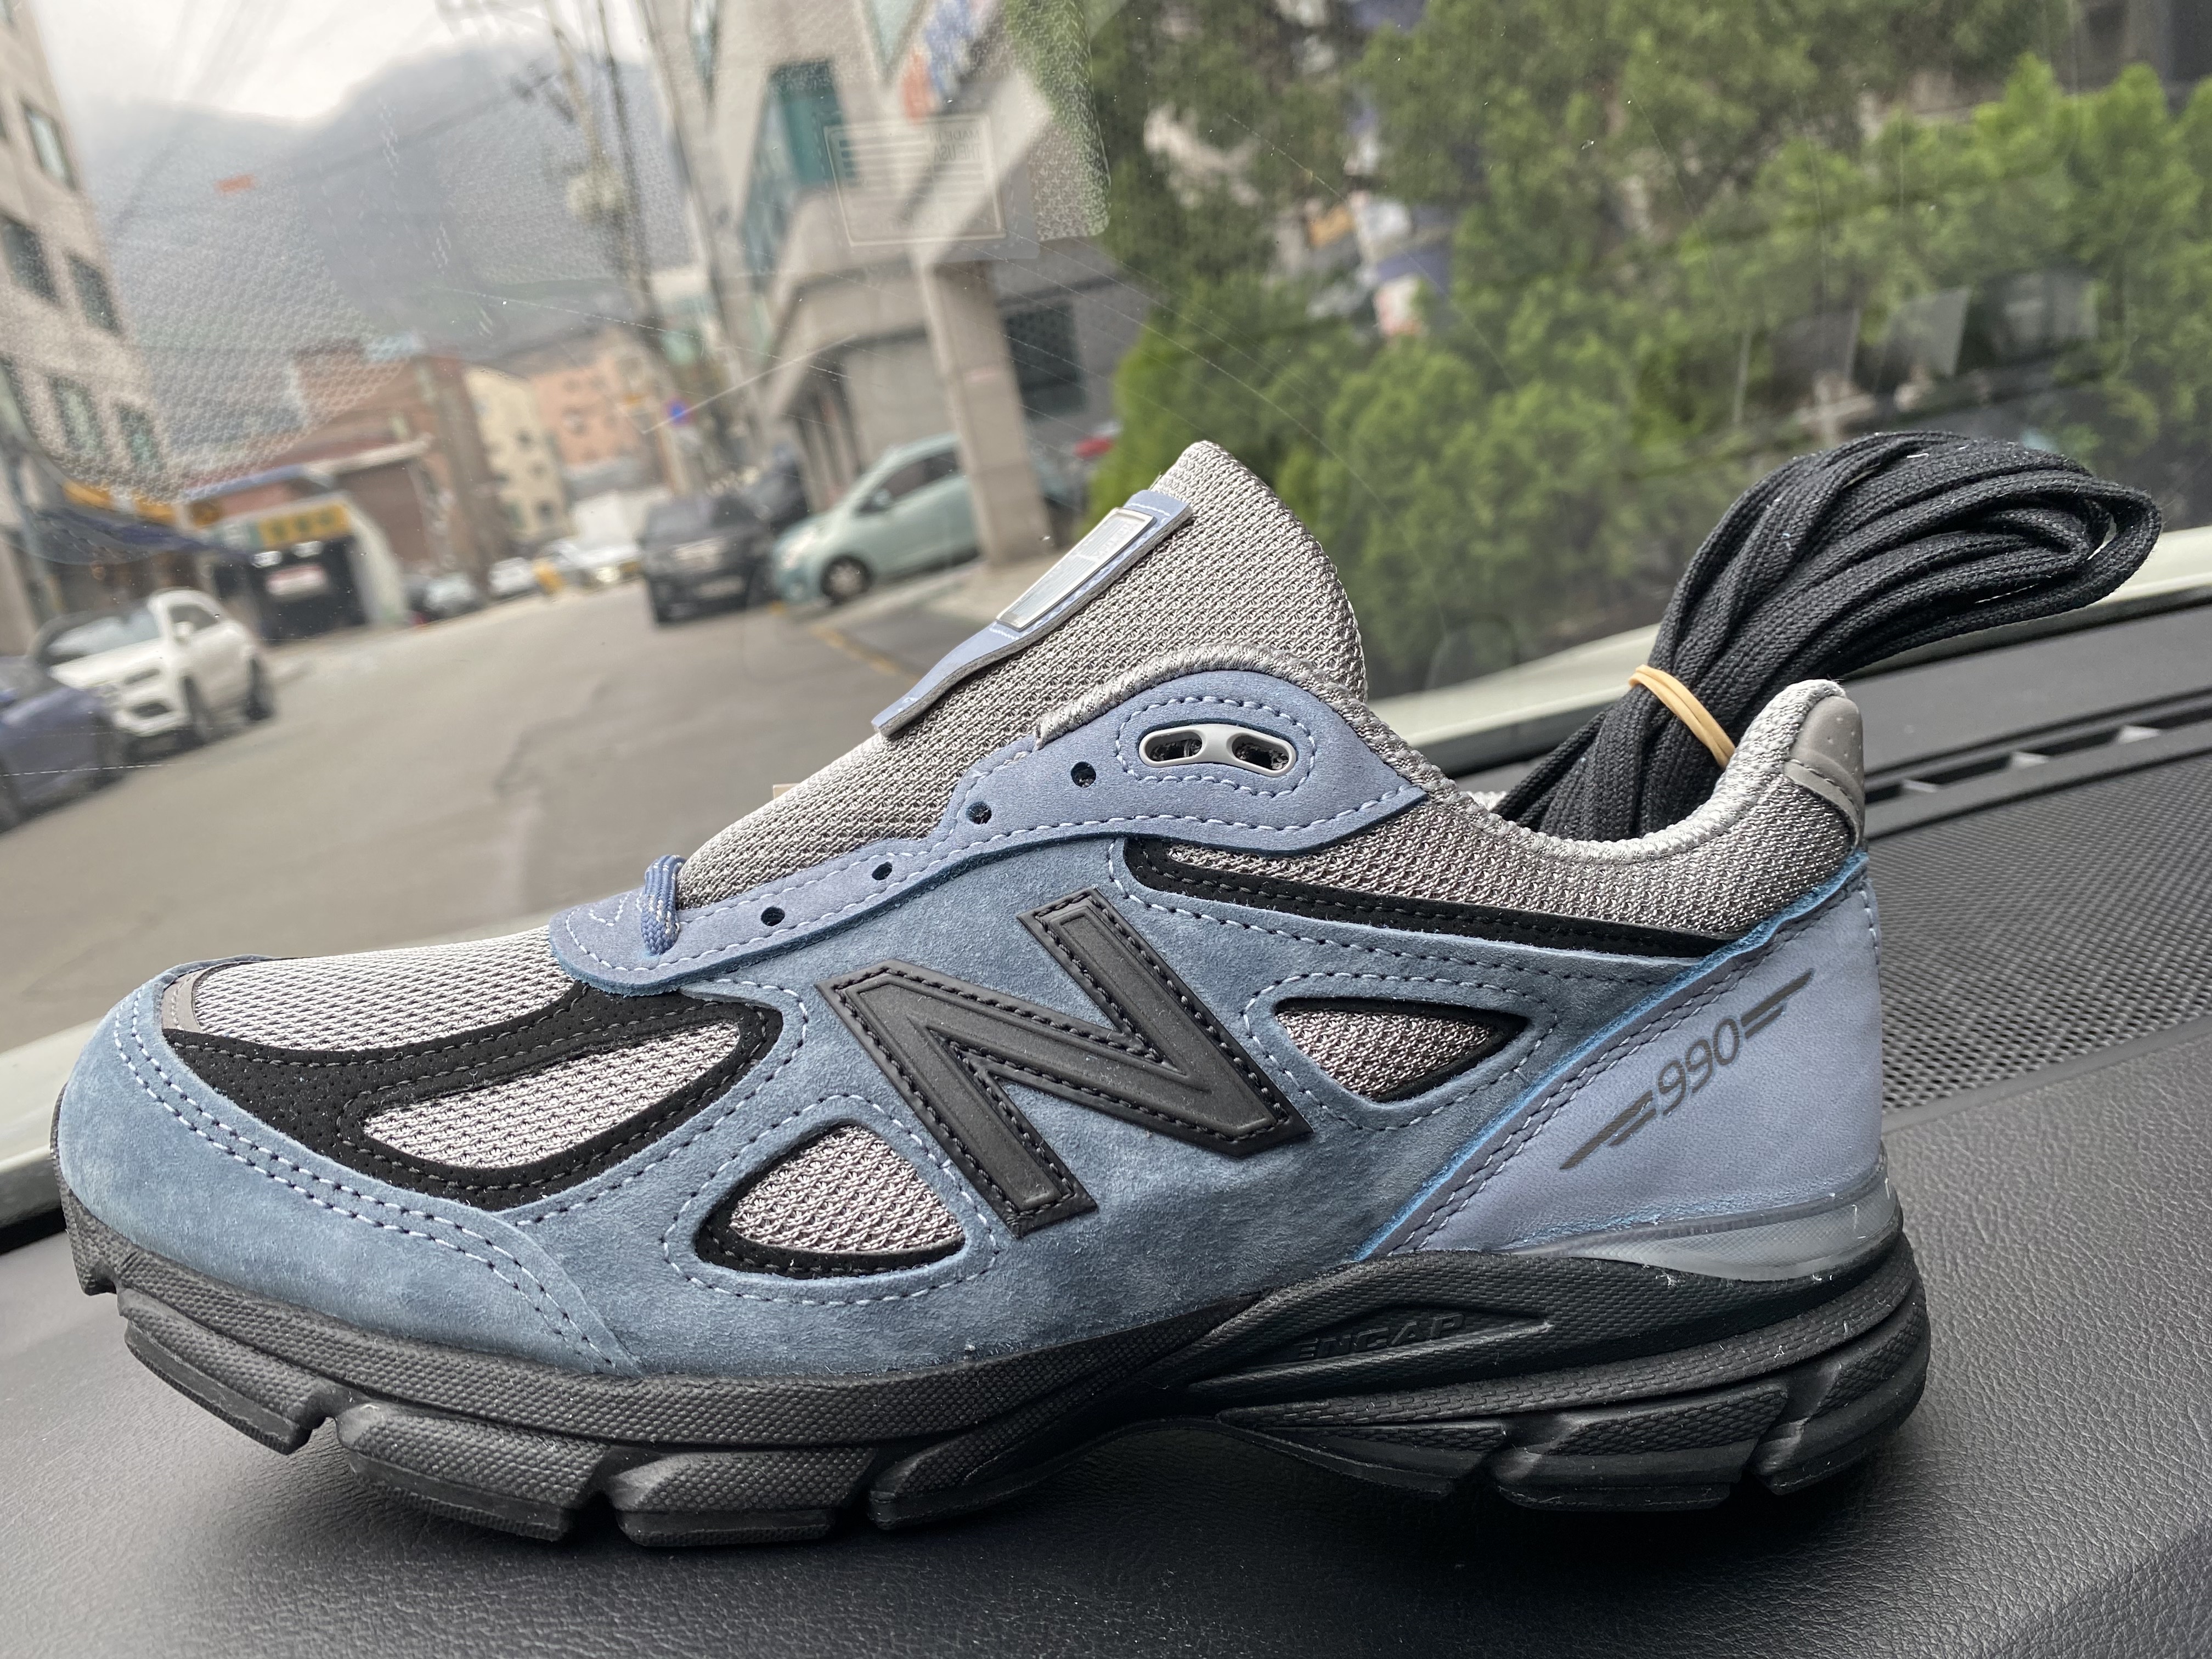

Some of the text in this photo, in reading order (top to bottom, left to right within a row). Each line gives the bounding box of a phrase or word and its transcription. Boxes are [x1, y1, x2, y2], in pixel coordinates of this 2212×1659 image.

[814, 887, 1313, 1238] N
[1657, 1018, 1740, 1116] 990
[1287, 1312, 1466, 1362] ENCAP
